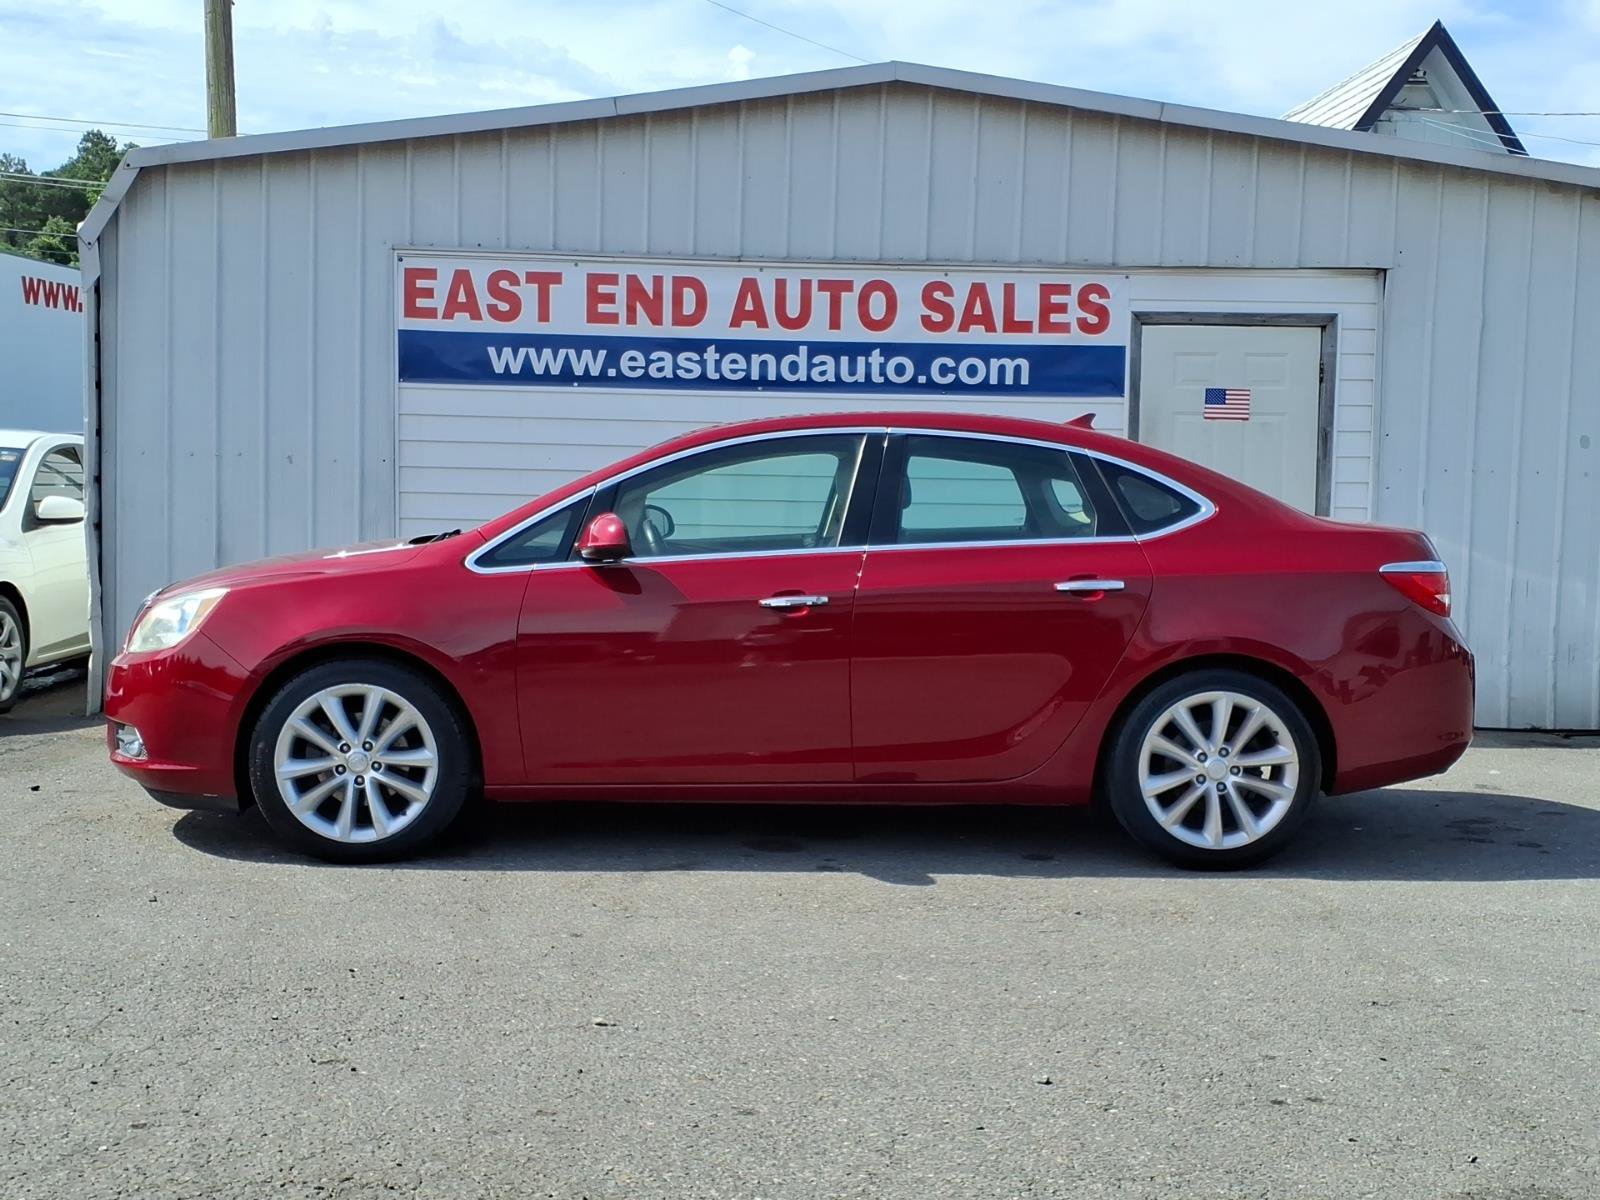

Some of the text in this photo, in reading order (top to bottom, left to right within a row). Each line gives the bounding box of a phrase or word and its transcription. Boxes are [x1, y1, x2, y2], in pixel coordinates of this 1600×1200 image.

[403, 267, 1111, 335] EAST END AUTO SALES
[487, 344, 1030, 385] www.eastendauto.com
